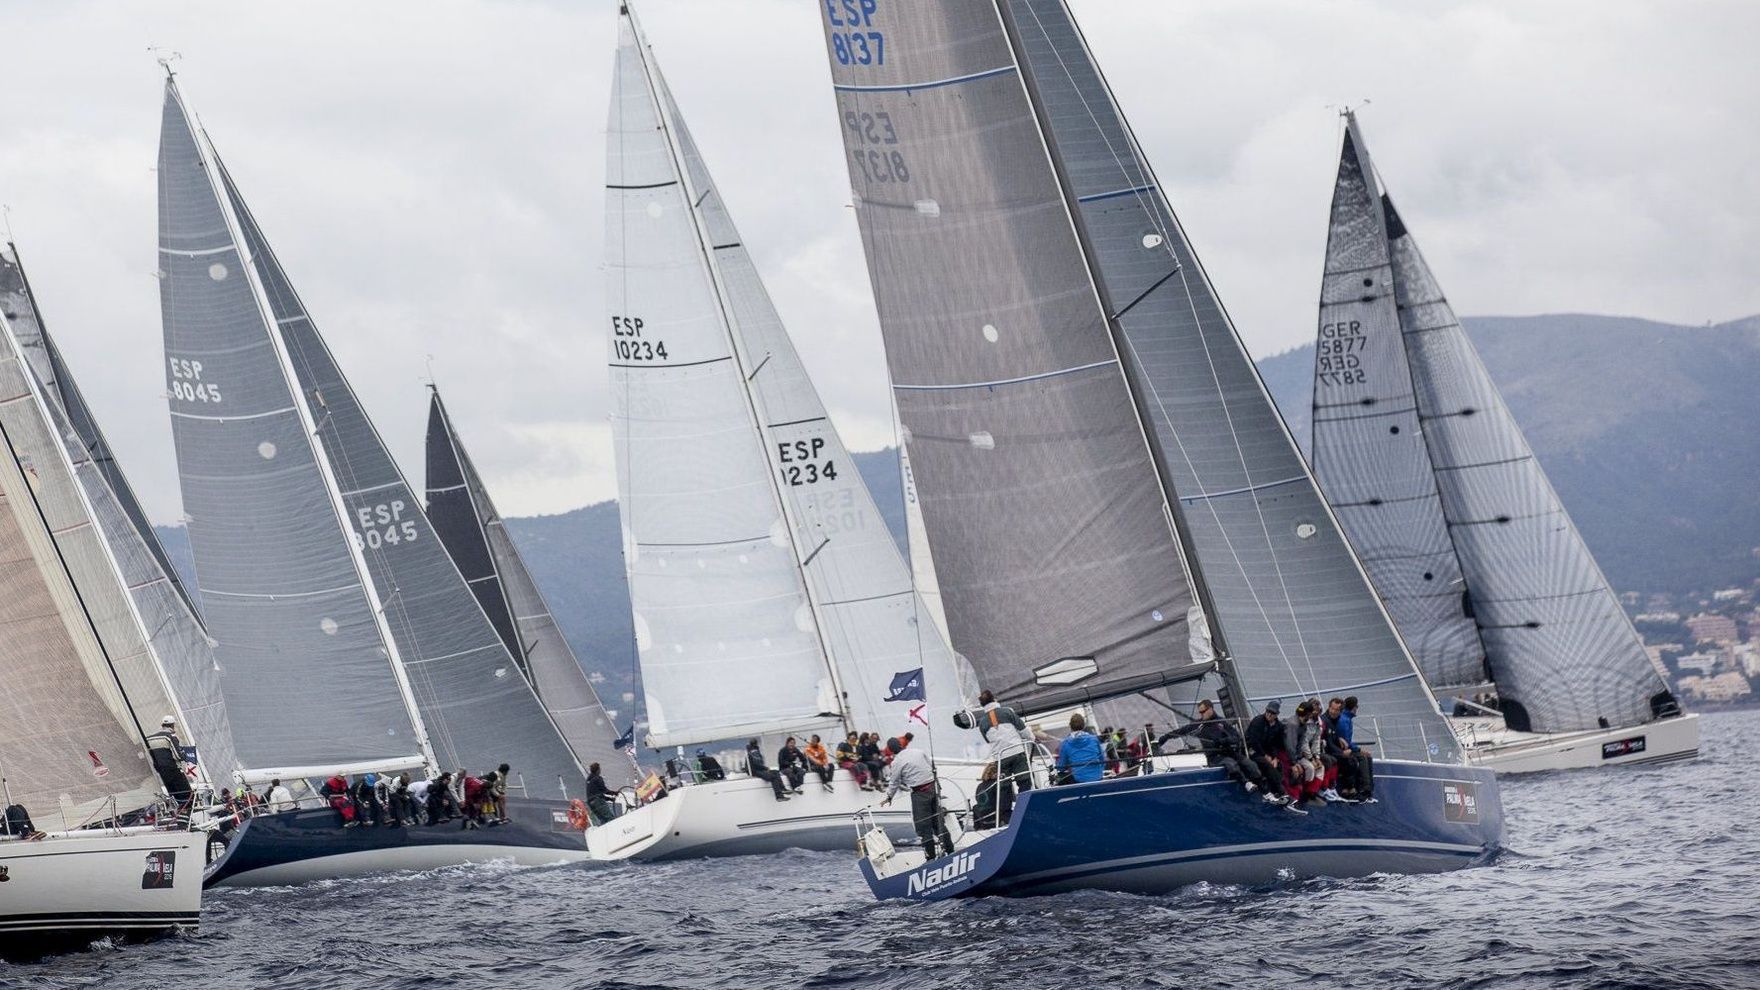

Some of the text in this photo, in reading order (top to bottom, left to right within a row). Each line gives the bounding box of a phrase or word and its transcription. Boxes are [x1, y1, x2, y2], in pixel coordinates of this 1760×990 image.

[825, 0, 877, 27] ESP
[832, 32, 884, 65] 8137
[612, 316, 643, 337] ESP
[1323, 320, 1361, 338] GER
[614, 340, 668, 360] 10234
[1322, 336, 1367, 355] 5877
[170, 357, 203, 380] ESP
[173, 381, 222, 403] 8045
[778, 438, 825, 463] ESP
[358, 500, 405, 528] ESP
[907, 851, 982, 897] Nadir
